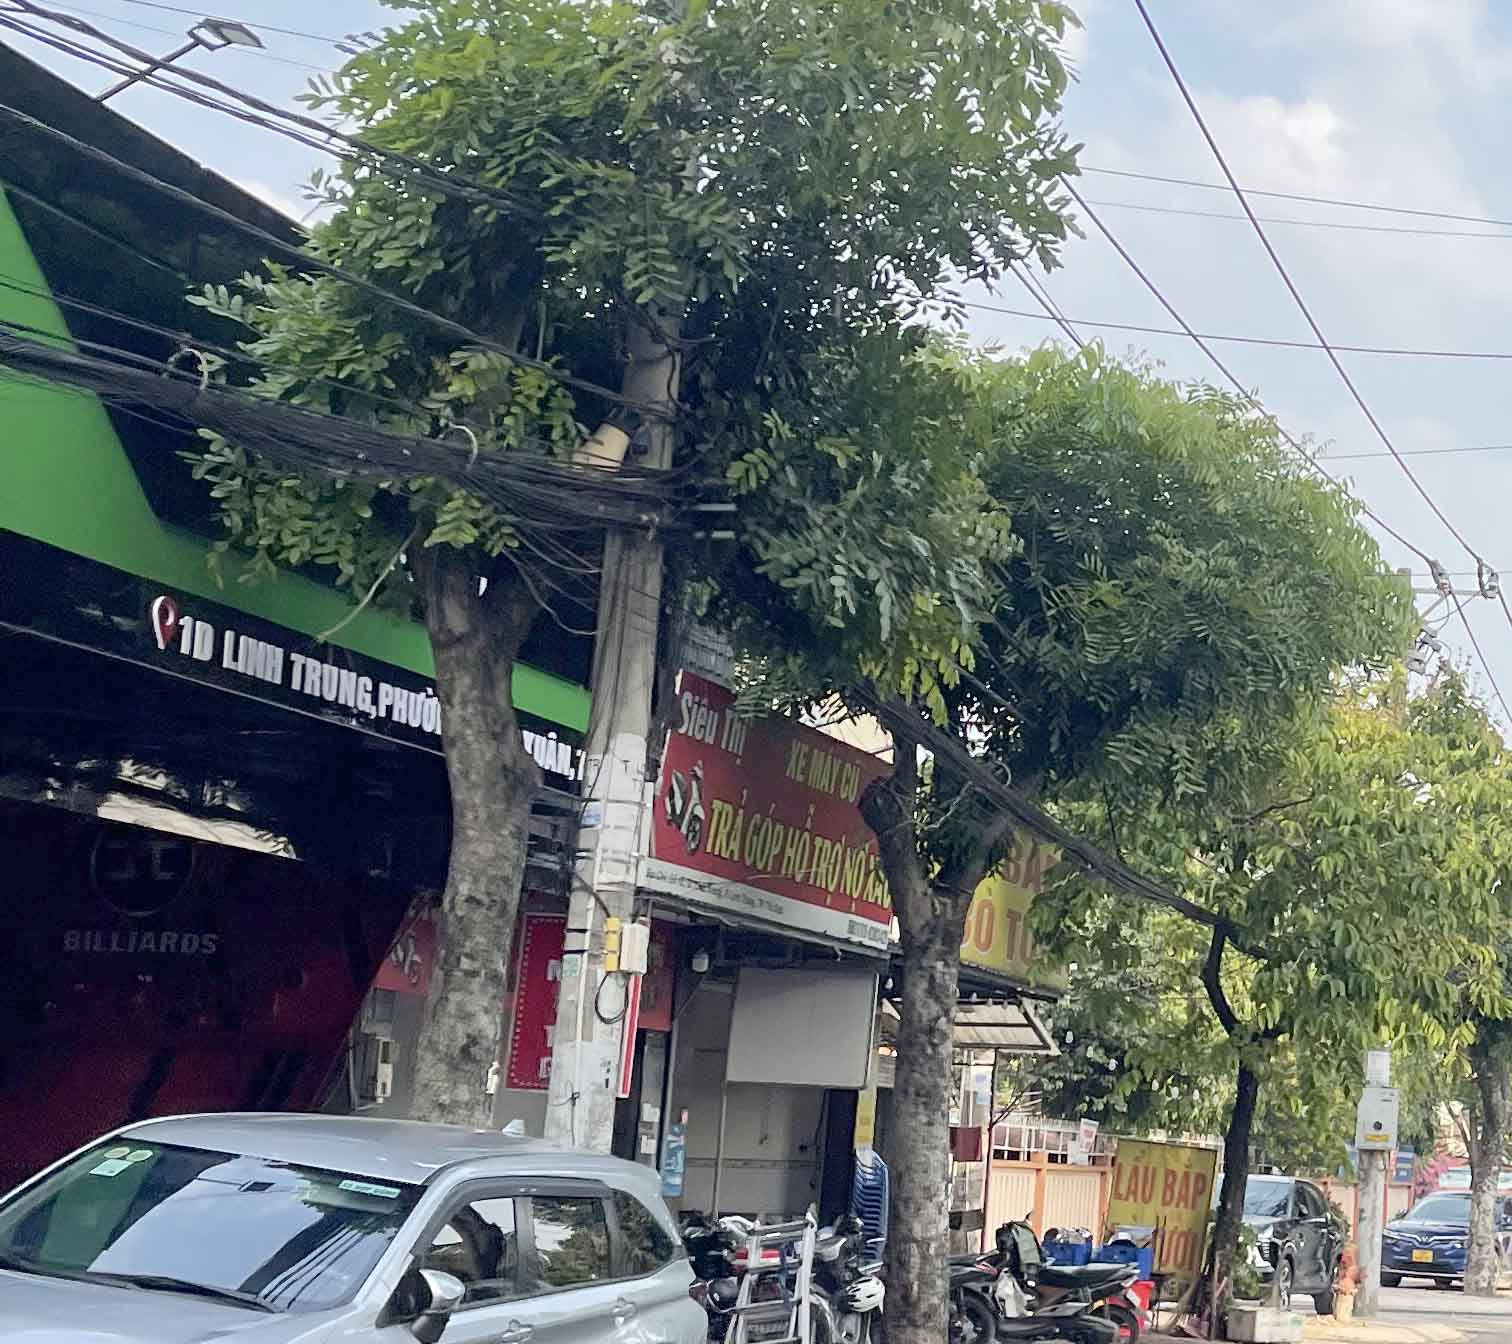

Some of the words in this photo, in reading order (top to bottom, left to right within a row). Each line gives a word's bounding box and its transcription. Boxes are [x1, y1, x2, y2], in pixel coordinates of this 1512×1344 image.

[178, 615, 214, 661] 1D
[222, 629, 284, 685] LINH
[677, 690, 718, 744] Siêu
[745, 802, 784, 873] GÓP
